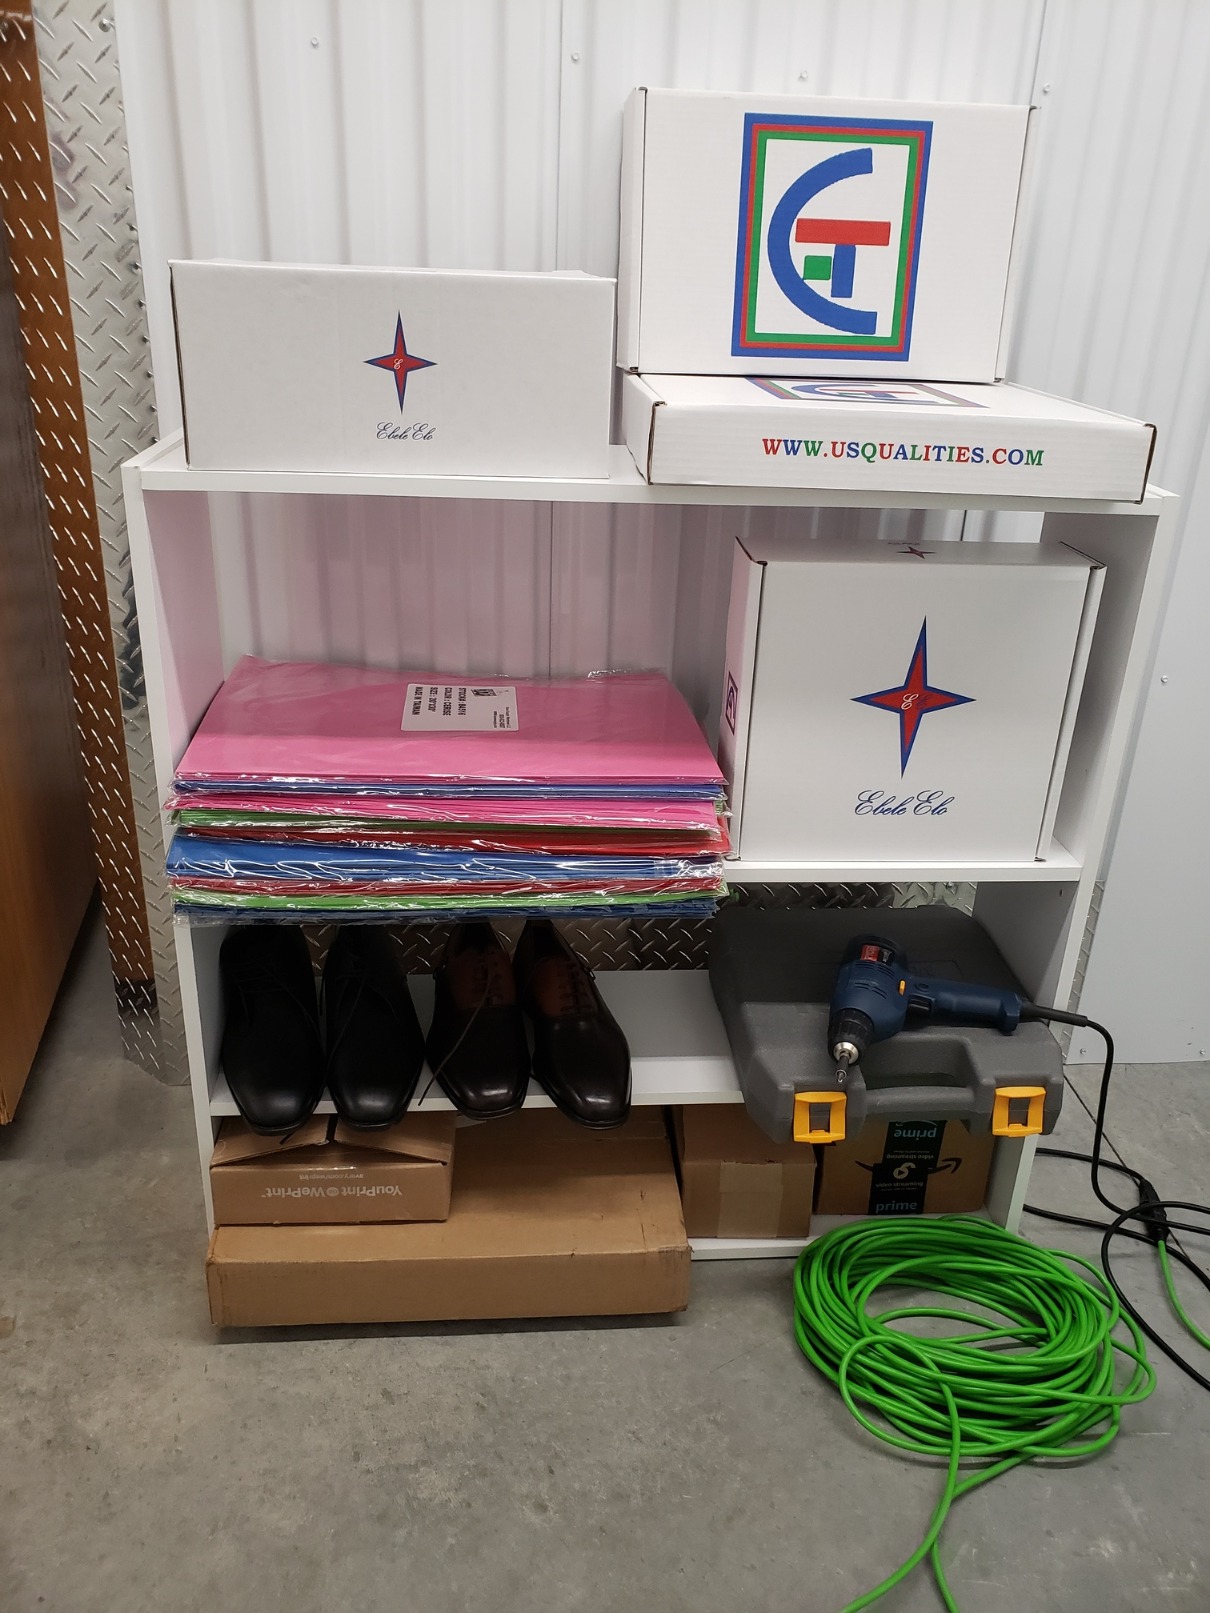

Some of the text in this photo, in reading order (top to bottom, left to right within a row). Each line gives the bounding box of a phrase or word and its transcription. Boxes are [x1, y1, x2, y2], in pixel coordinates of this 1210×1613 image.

[376, 422, 436, 440] Ebele Elo
[762, 438, 1044, 466] WWW.USQUALITIES.COM
[854, 790, 955, 816] Ebele Elo
[893, 1127, 937, 1140] prime
[341, 1185, 402, 1197] YouPrint
[875, 1200, 918, 1214] prime
